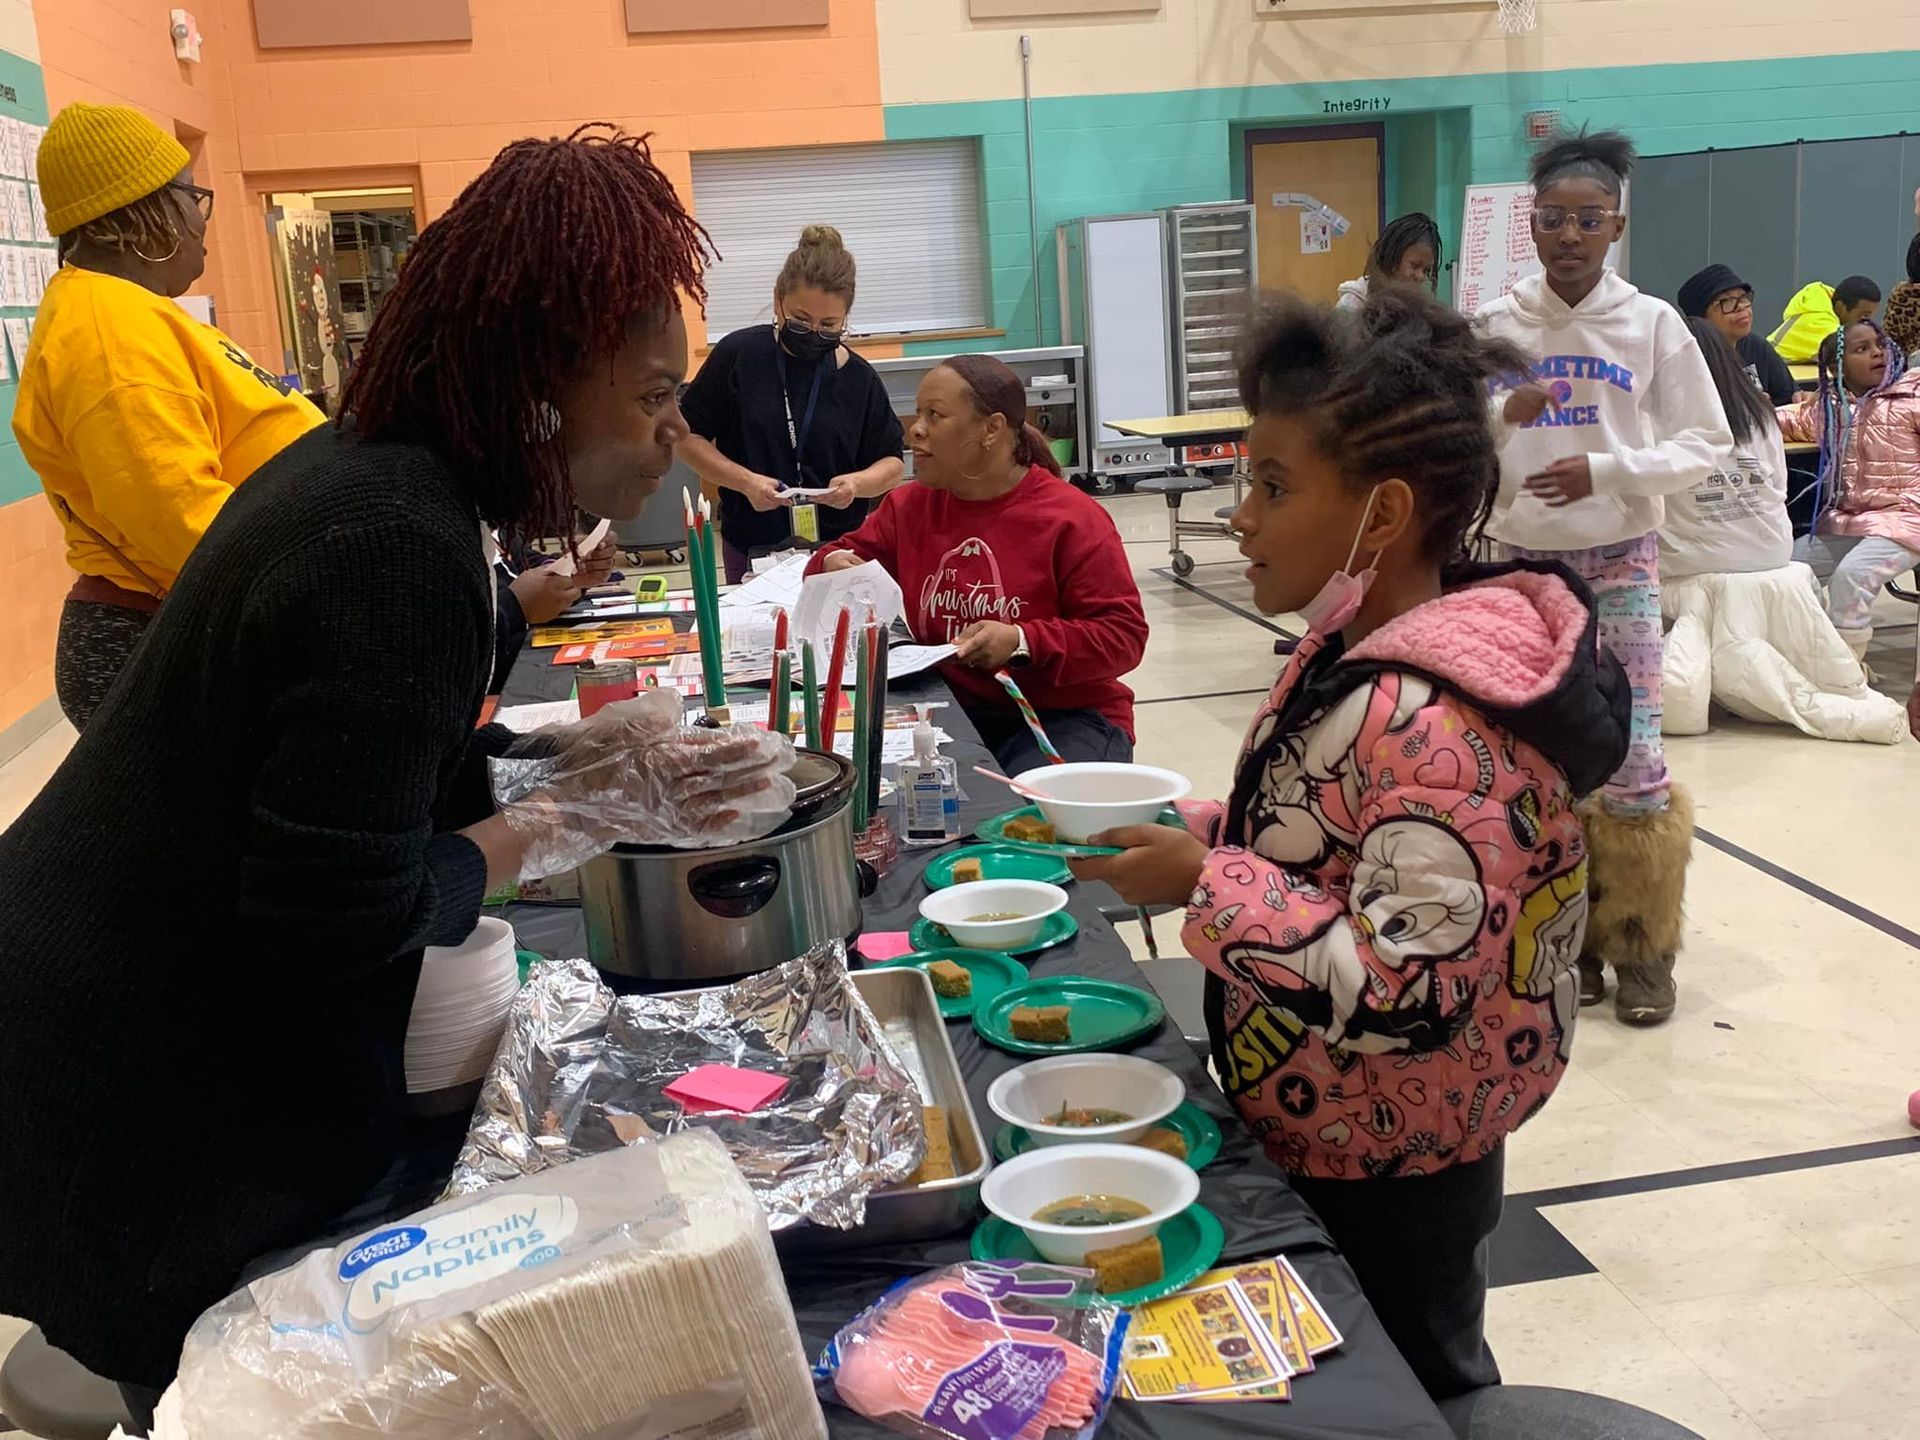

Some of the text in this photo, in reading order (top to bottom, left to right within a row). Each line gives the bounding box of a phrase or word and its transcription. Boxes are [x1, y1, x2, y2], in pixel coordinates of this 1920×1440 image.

[1323, 97, 1391, 113] Integrity
[1520, 405, 1599, 428] ANCE
[920, 570, 1029, 619] Christmas
[1463, 729, 1494, 794] POSITIVE
[346, 1231, 411, 1266] Great
[425, 1208, 538, 1256] Family
[362, 1242, 412, 1263] Value
[373, 1229, 545, 1305] Napkins
[933, 1376, 962, 1416] HEAVY
[952, 1389, 993, 1424] 48
